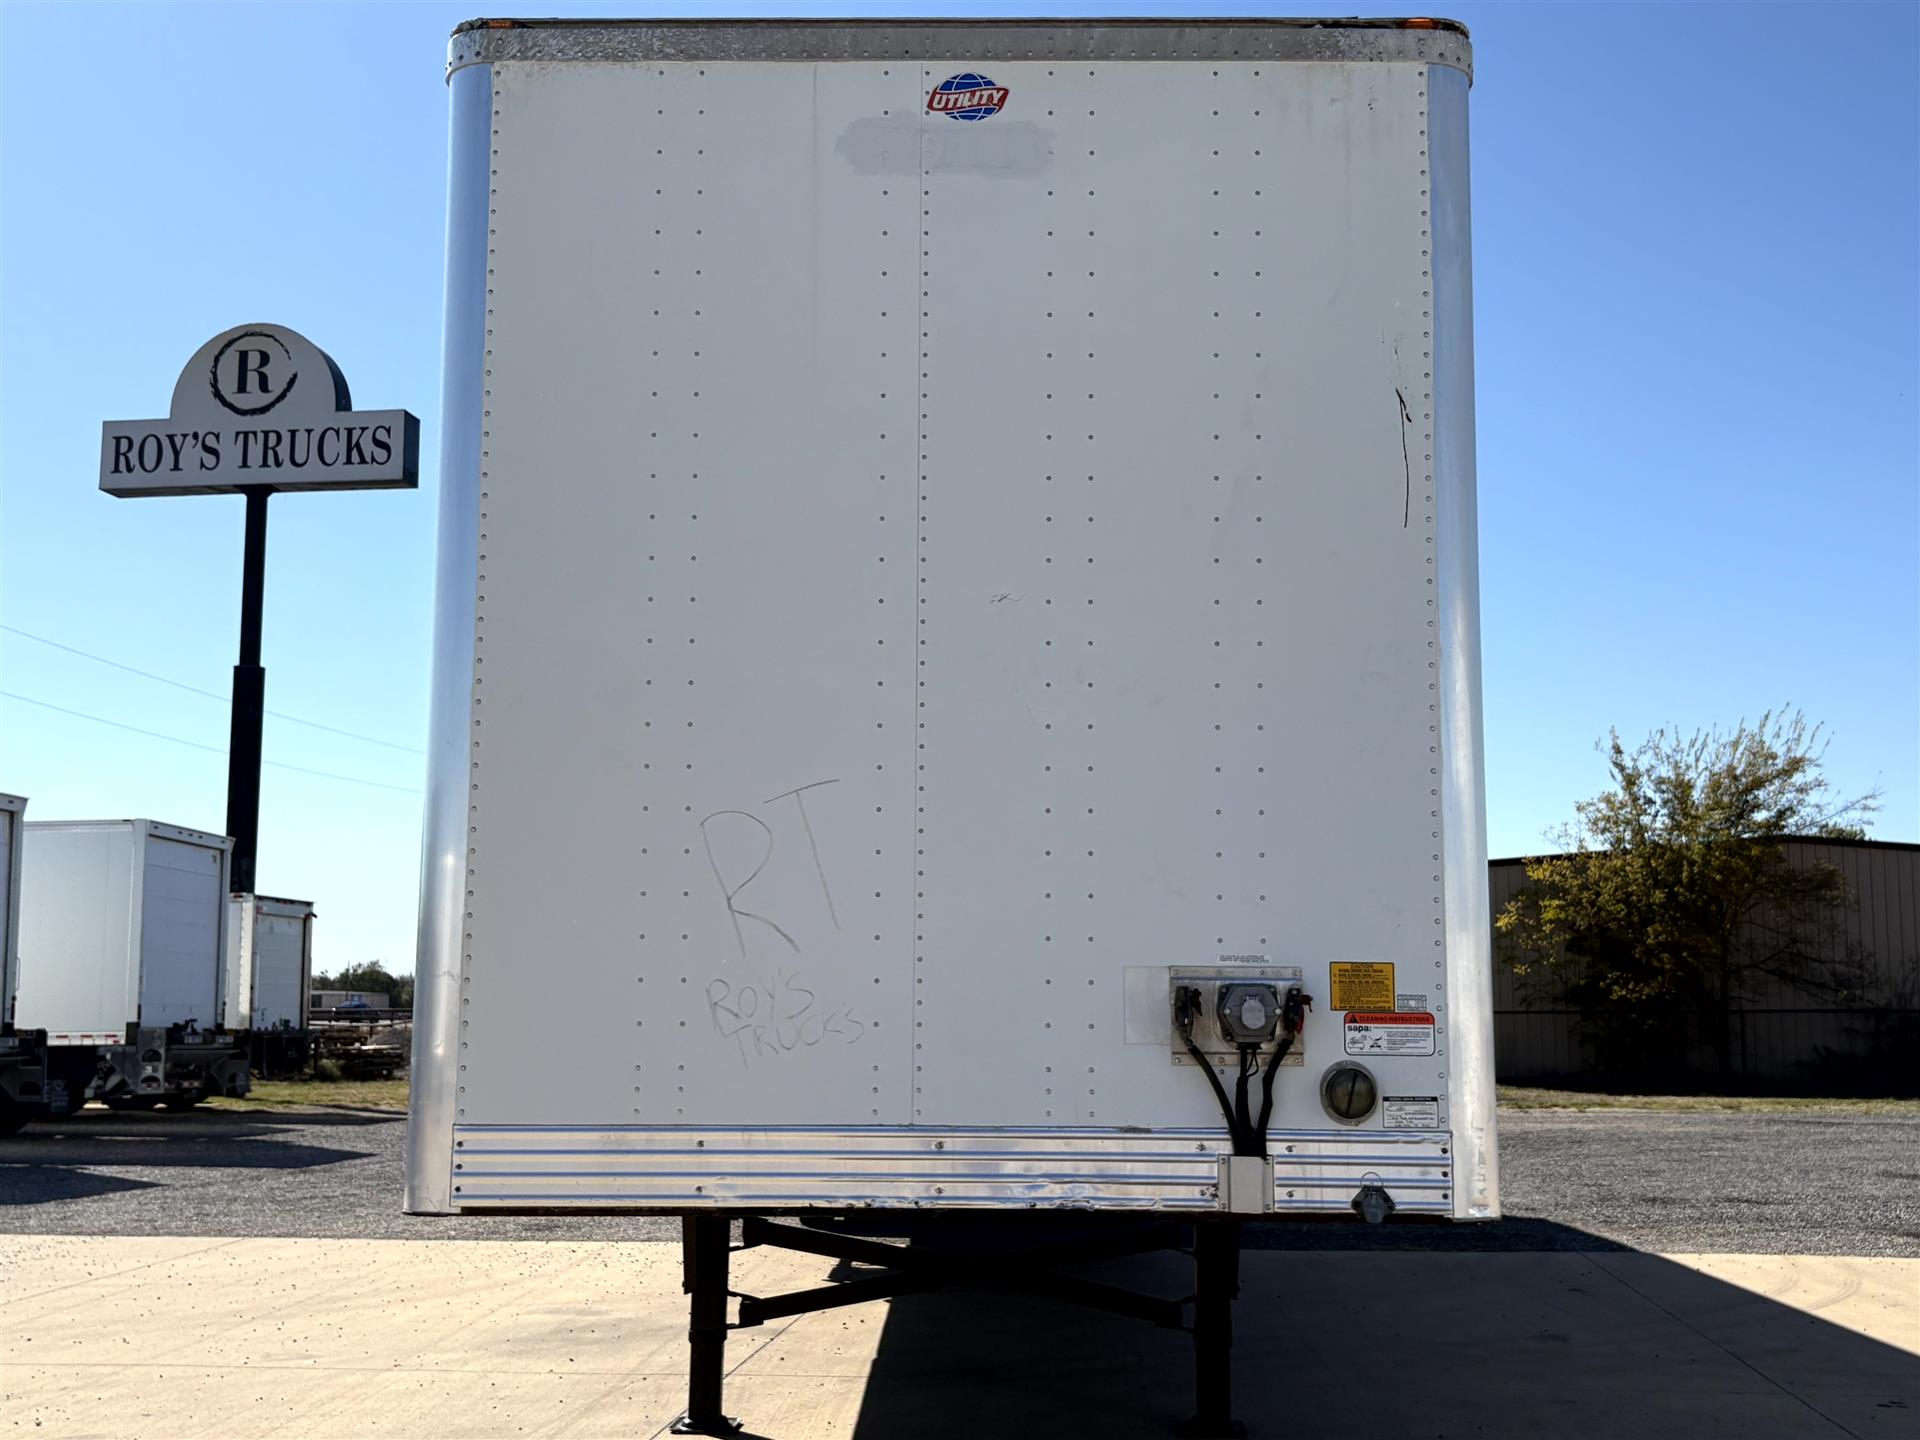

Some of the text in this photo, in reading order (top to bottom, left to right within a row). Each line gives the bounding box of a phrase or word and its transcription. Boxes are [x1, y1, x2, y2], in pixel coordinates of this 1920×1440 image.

[932, 89, 1004, 109] UTILITY
[231, 349, 273, 394] R
[110, 424, 393, 475] ROY'S TRUCKS
[700, 778, 841, 957] RT
[705, 966, 815, 1036] ROY'S
[1358, 1015, 1430, 1023] CLEANING INSTRUCTIONS
